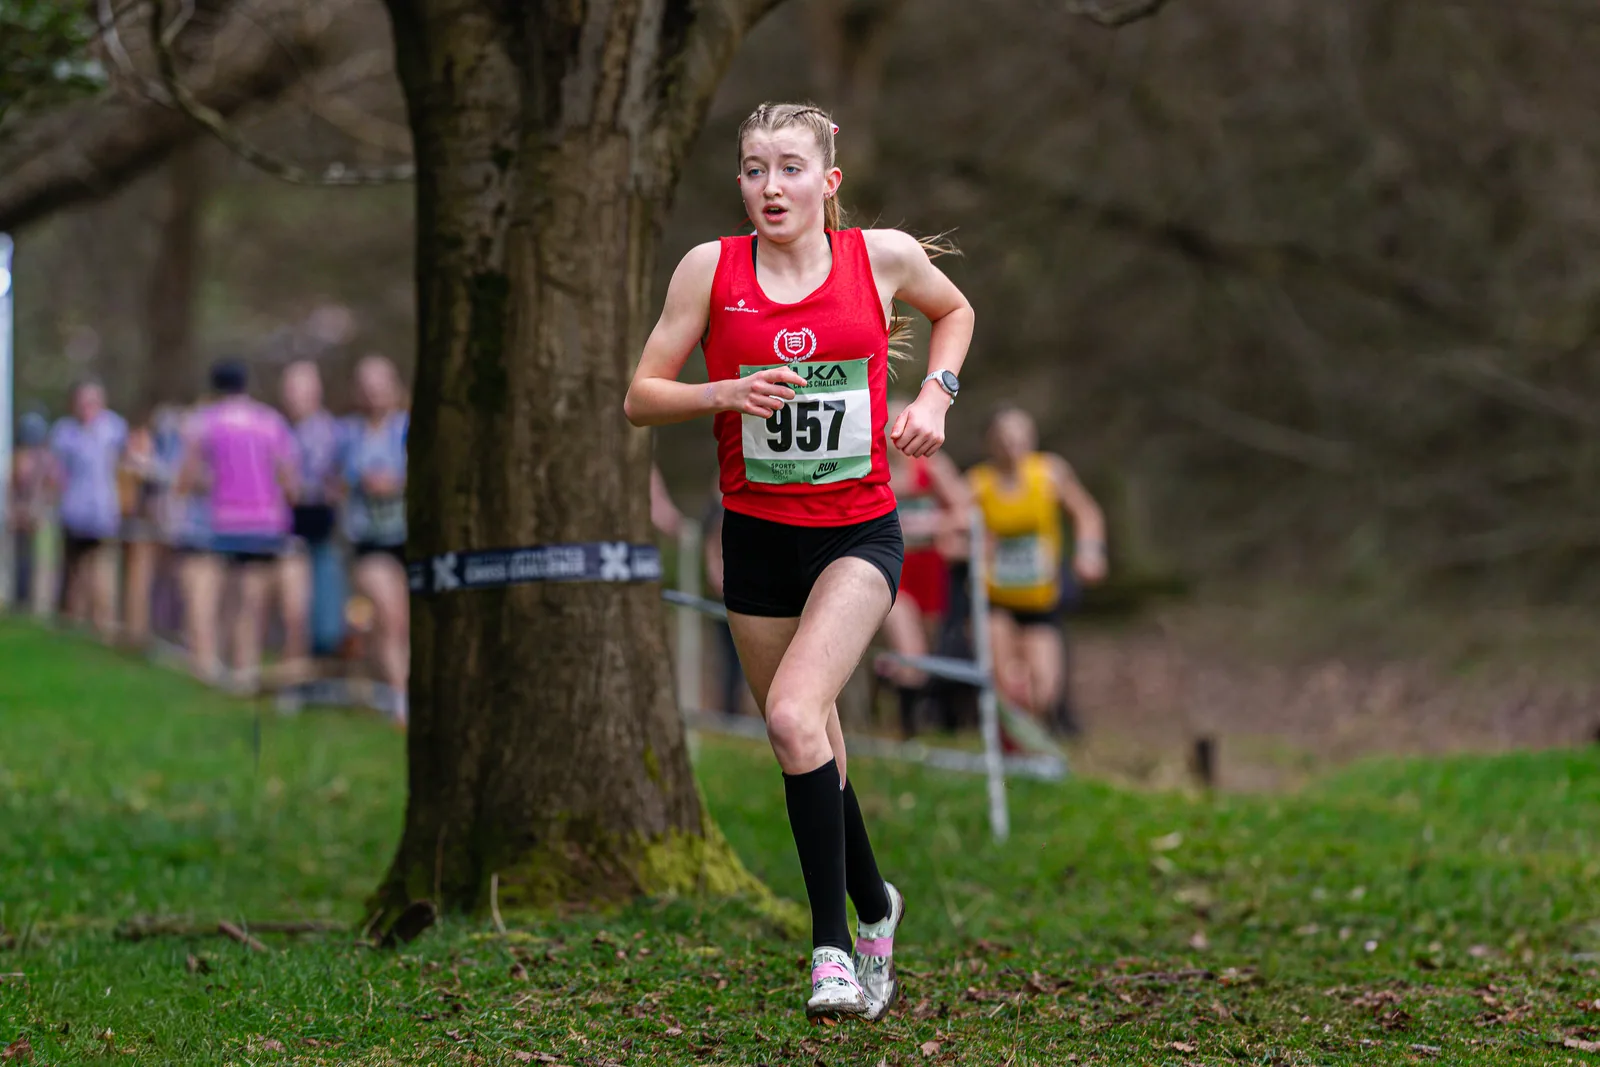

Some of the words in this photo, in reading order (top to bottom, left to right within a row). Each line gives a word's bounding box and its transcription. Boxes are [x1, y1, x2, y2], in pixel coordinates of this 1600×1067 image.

[813, 378, 848, 387] CHALLENGE
[765, 399, 846, 452] 957
[817, 462, 838, 472] RUN
